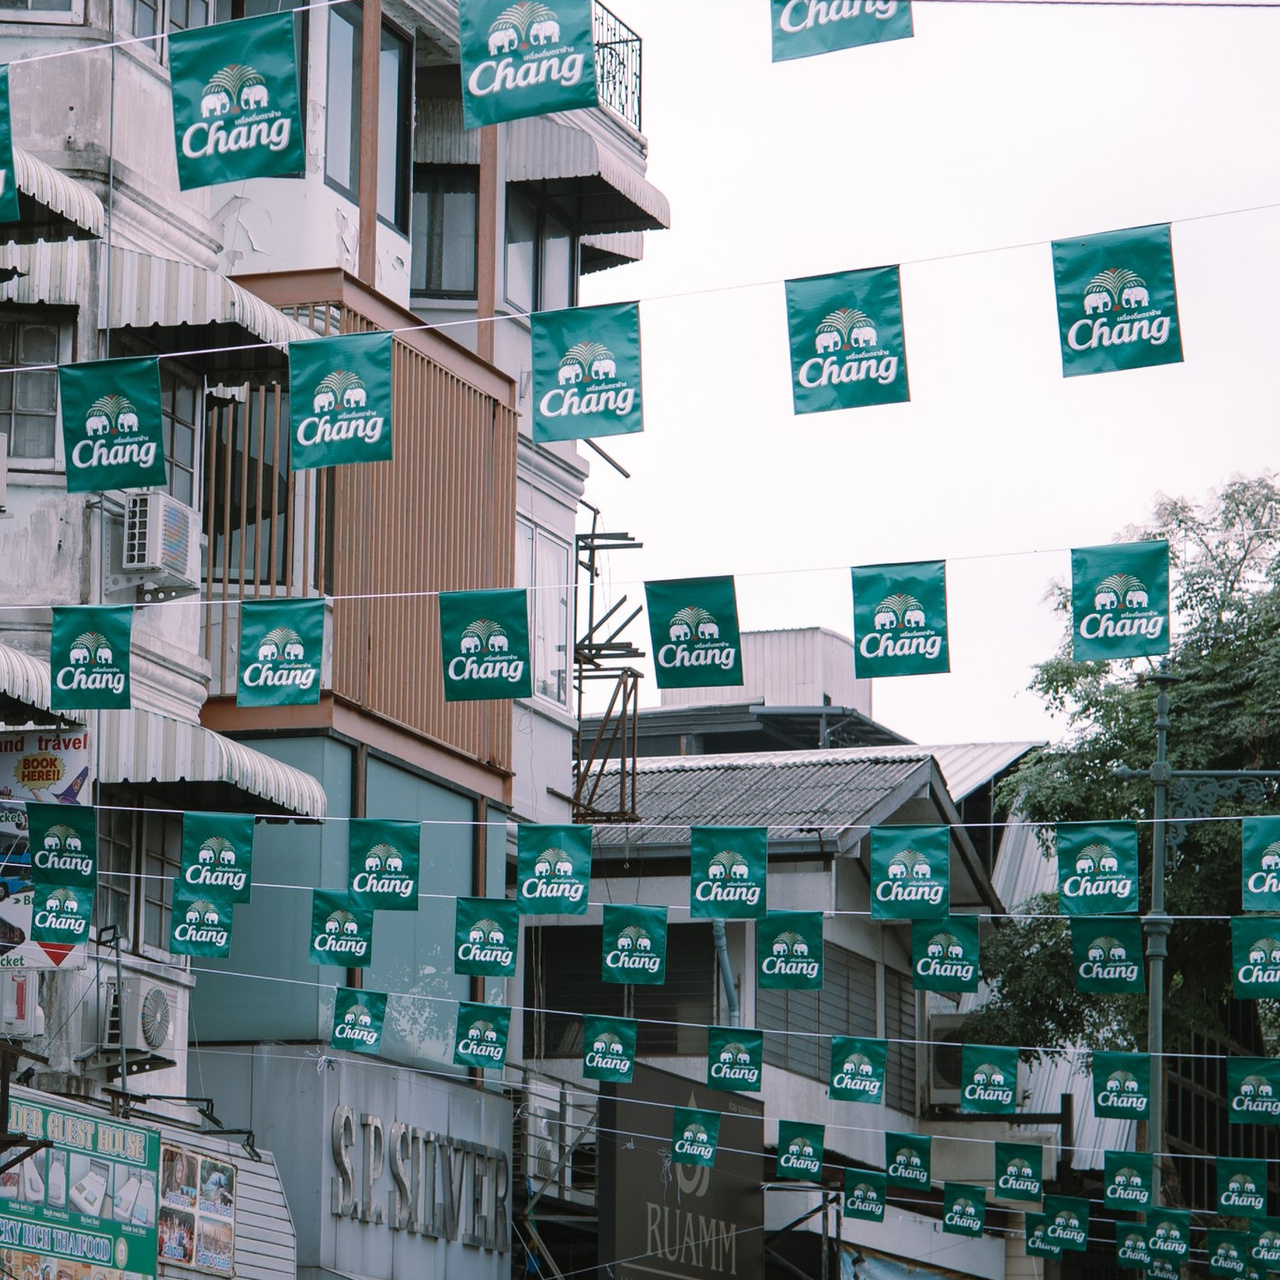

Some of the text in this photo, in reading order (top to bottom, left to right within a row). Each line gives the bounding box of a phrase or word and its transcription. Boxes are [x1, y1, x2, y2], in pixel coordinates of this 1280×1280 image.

[468, 48, 584, 94] Chang
[182, 119, 291, 158] Chang
[1068, 317, 1170, 350] Chang
[798, 356, 897, 388] Chang
[540, 388, 635, 417] Chang
[297, 416, 383, 445] Chang
[72, 440, 156, 468] Chang
[1080, 612, 1164, 640] Chang
[658, 645, 735, 669] Chang
[57, 667, 124, 693] Chang
[449, 657, 523, 682] Chang
[37, 734, 88, 751] travel
[22, 757, 58, 770] BOOK
[35, 851, 92, 875] Chang
[353, 873, 413, 897] Chang
[522, 878, 584, 901] Chang
[876, 881, 943, 904] Chang
[1063, 876, 1131, 897] Chang
[34, 906, 87, 934] Chang
[174, 914, 227, 946] Chang
[458, 944, 513, 966] Chang
[606, 951, 660, 972] Chang
[917, 958, 973, 980] Chang
[1079, 962, 1138, 981] Chang
[458, 1039, 503, 1060] Chang
[586, 1053, 630, 1072] Chang
[834, 1074, 880, 1094] Chang
[965, 1085, 1012, 1104] Chang
[47, 1113, 96, 1150] GUEST
[97, 1122, 146, 1161] HOUSE
[675, 1141, 713, 1158] Chang
[780, 1154, 819, 1172] Chang
[999, 1176, 1039, 1193] Chang
[1107, 1185, 1148, 1203] Chang
[847, 1199, 883, 1215] Chang
[945, 1213, 981, 1231] Chang
[22, 1223, 52, 1249] RICH
[52, 1228, 111, 1261] THAIFOOD
[646, 1201, 737, 1275] RUAMM
[1149, 1238, 1186, 1254] Chang
[1211, 1256, 1243, 1271] Chang
